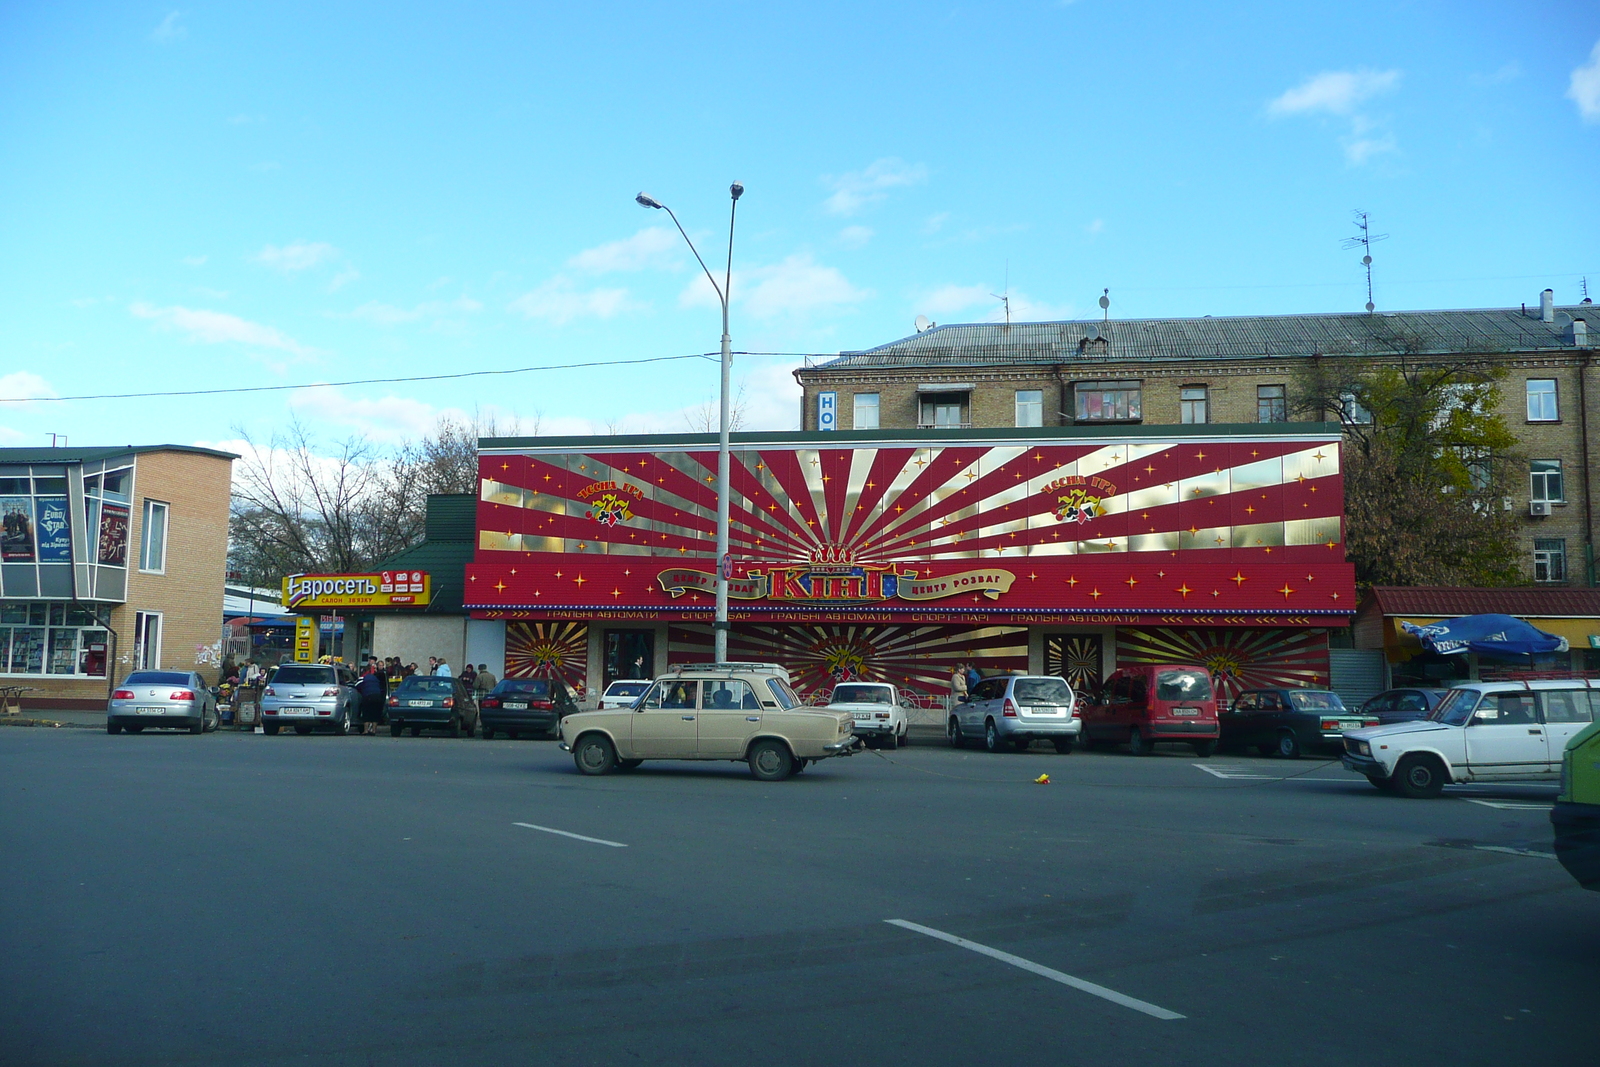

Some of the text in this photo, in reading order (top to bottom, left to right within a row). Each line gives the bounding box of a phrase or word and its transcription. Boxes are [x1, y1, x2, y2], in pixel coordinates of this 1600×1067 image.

[621, 482, 644, 501] ГРА
[1091, 476, 1117, 497] ГРА
[673, 575, 707, 585] ЦЕНТР
[912, 575, 1000, 595] ЦЕНТР РОЗВАГ
[287, 573, 377, 603] Евросеть
[547, 610, 659, 619] ГРАЛЬНІ АВТОМАТИ
[961, 613, 989, 622] ПАРІ
[1010, 614, 1140, 623] ГРАЛЬНІ АВТОМАТИ
